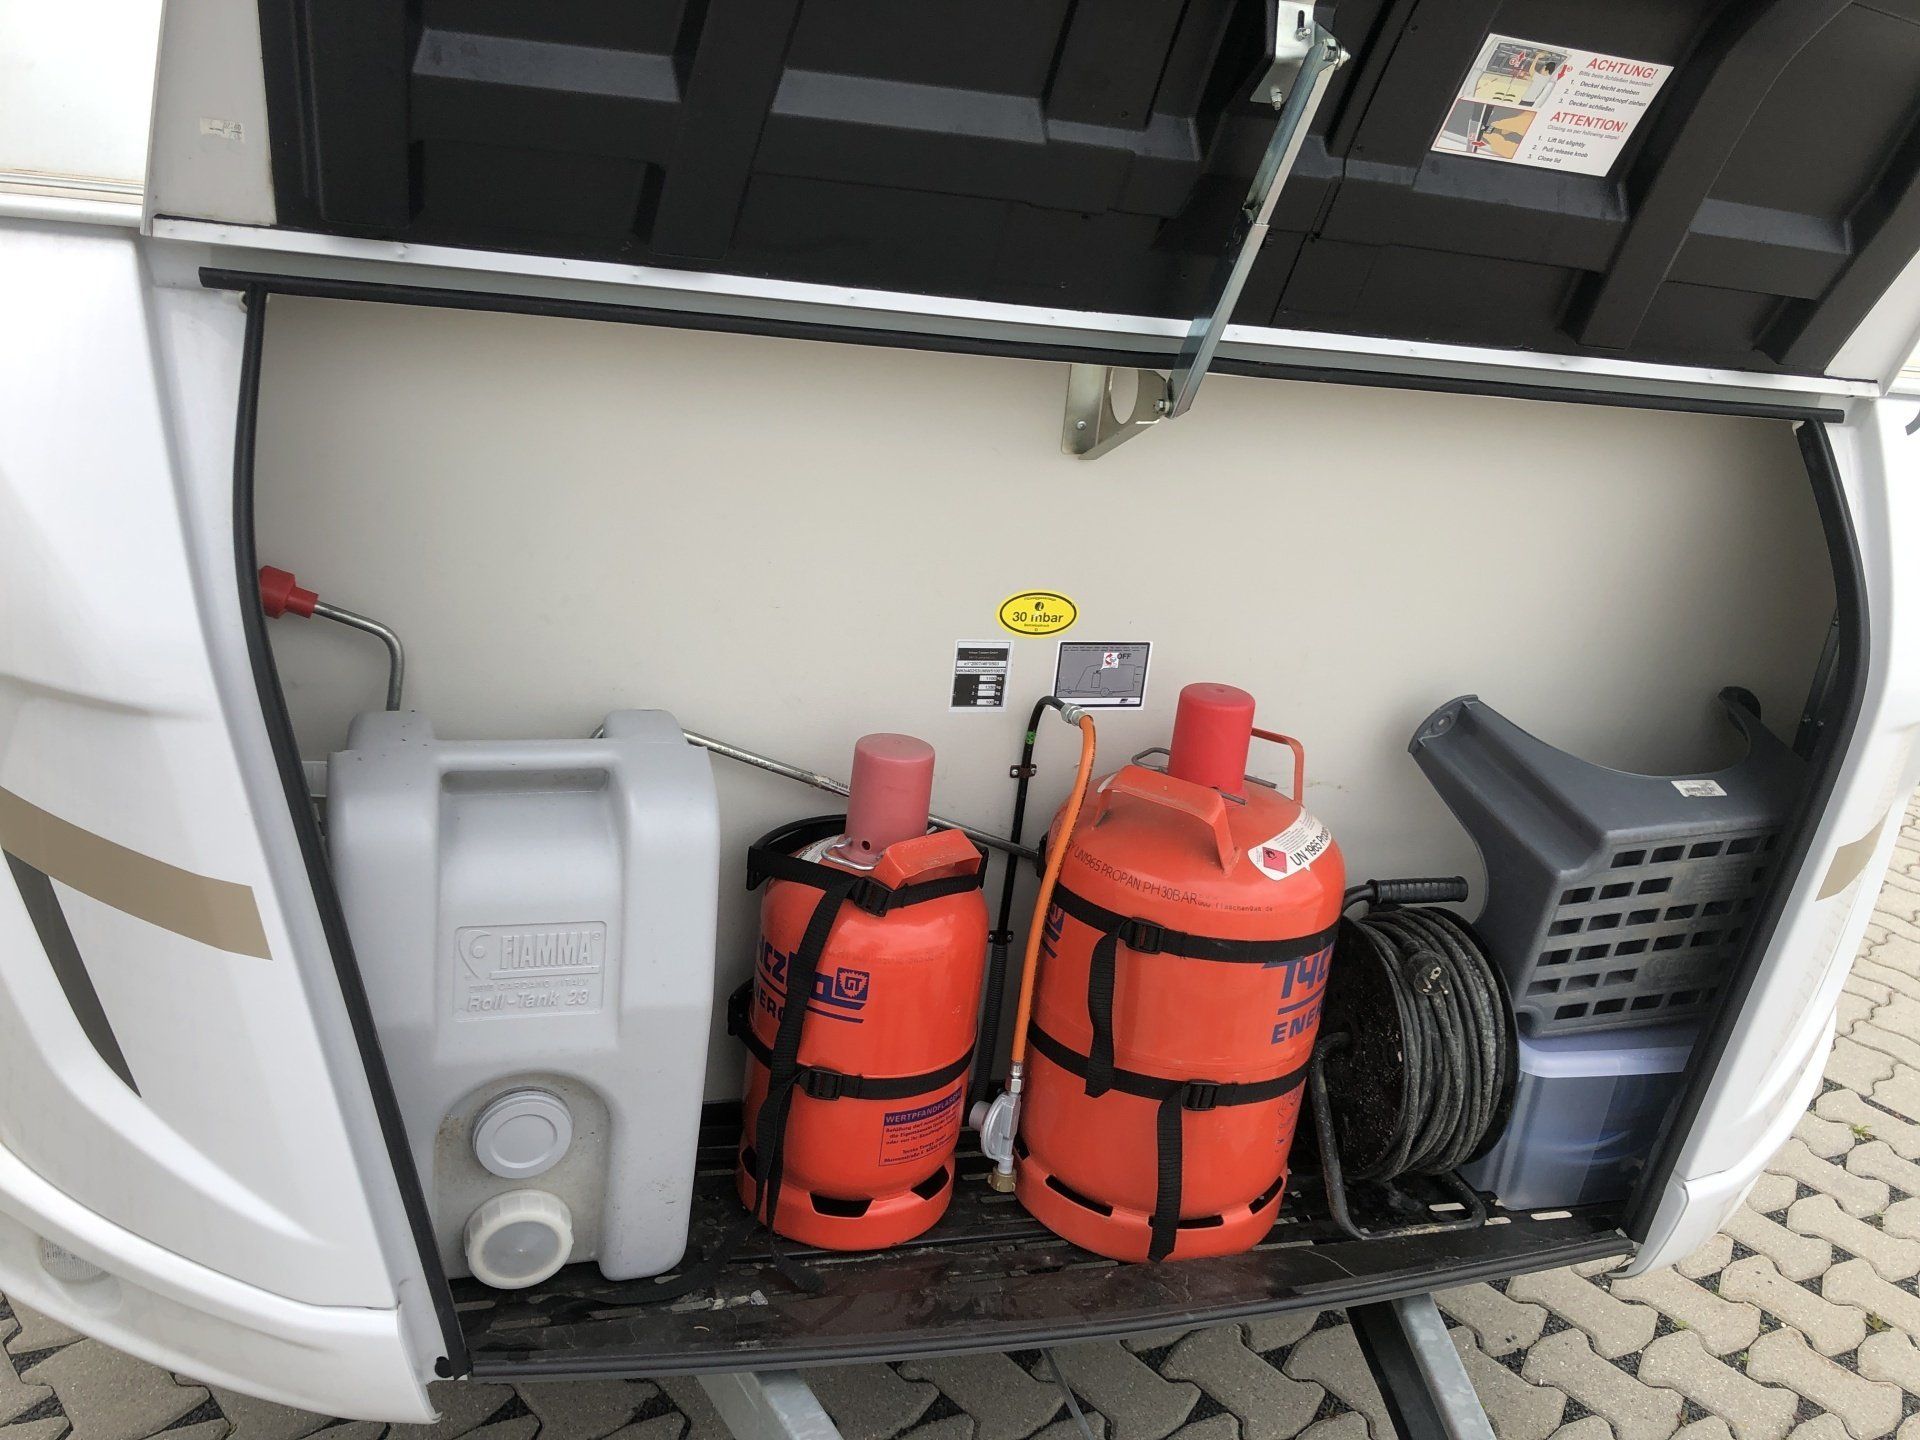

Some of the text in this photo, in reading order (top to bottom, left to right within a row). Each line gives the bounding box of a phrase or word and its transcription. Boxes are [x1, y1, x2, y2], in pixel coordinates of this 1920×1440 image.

[1586, 58, 1659, 79] ACHTUNG!
[1580, 80, 1600, 89] Deckel
[1599, 84, 1616, 93] leicht
[1616, 87, 1640, 96] anheben
[1569, 99, 1589, 108] Deckel
[1550, 111, 1628, 133] ATTENTION!
[1565, 139, 1586, 149] slightly
[1537, 155, 1553, 163] Close
[1012, 611, 1027, 622] 30
[1117, 652, 1132, 660] OFF
[1290, 850, 1309, 866] UN
[1305, 839, 1322, 857] 1965
[1101, 863, 1142, 891] PROPAN
[500, 932, 592, 970] FIAMMA
[565, 989, 589, 1006] 23
